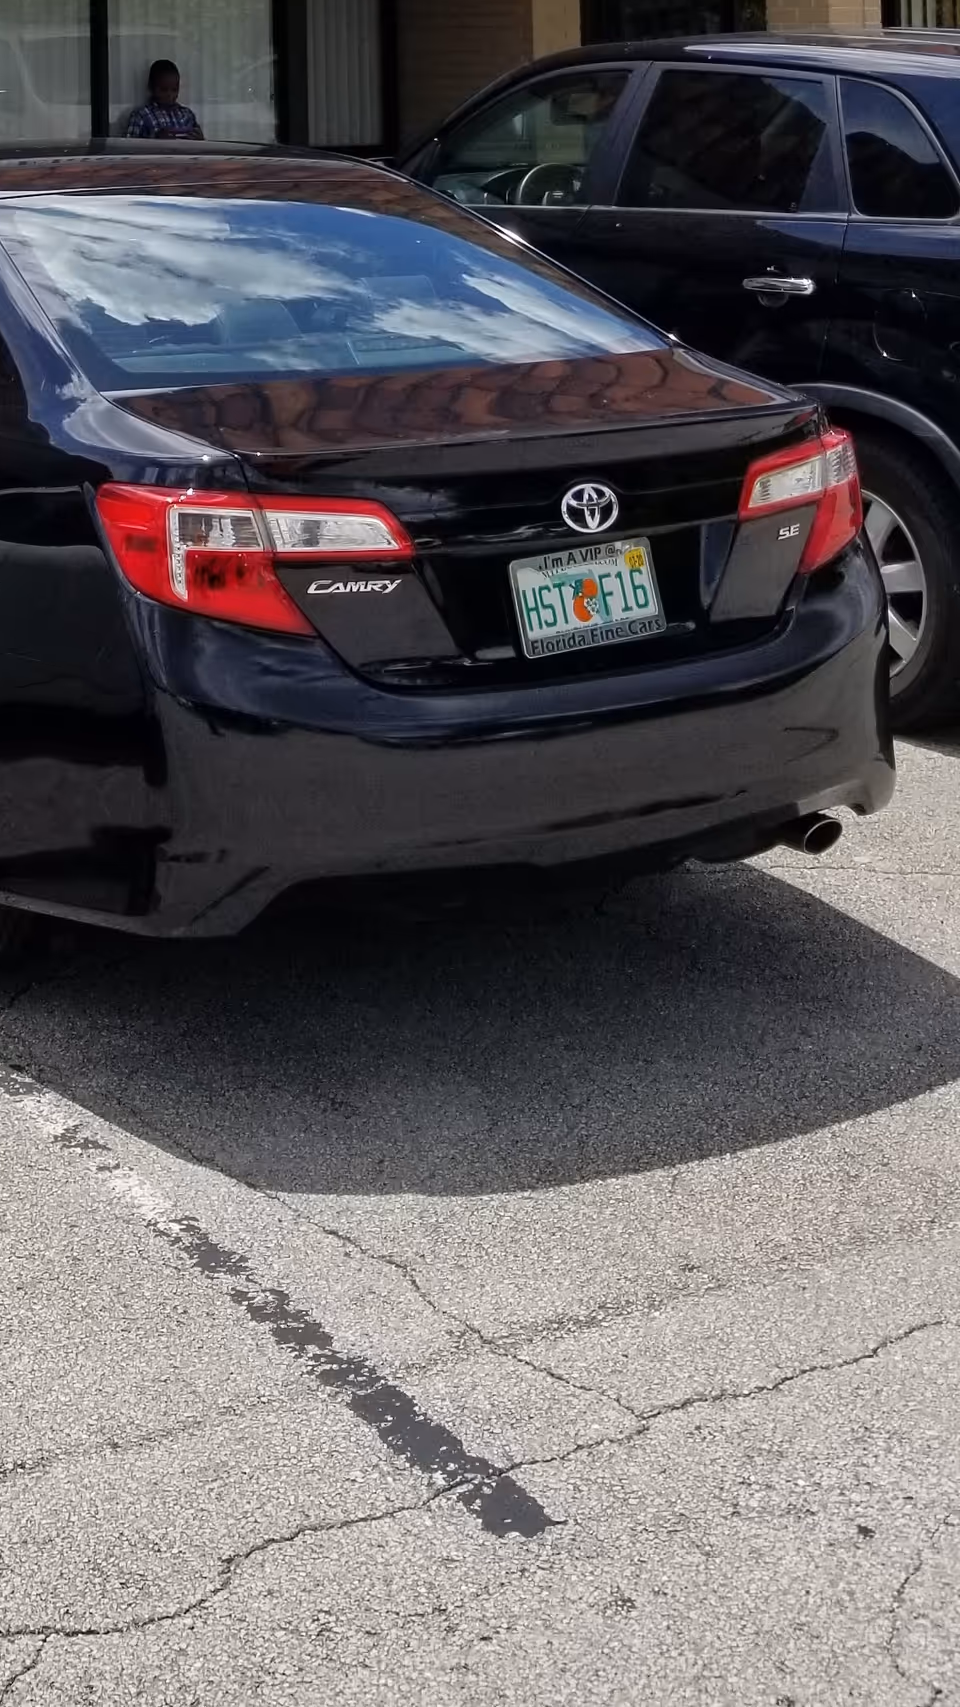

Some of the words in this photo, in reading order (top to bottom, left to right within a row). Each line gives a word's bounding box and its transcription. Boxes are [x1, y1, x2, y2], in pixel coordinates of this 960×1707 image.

[777, 523, 800, 540] SE
[543, 554, 564, 570] I'm
[567, 551, 578, 566] A
[579, 546, 602, 562] VIP
[307, 579, 402, 594] CAMRY
[521, 582, 569, 632] HST
[598, 569, 650, 617] F16
[530, 632, 586, 656] Florida
[591, 625, 626, 643] Fine
[628, 617, 662, 635] Cars
